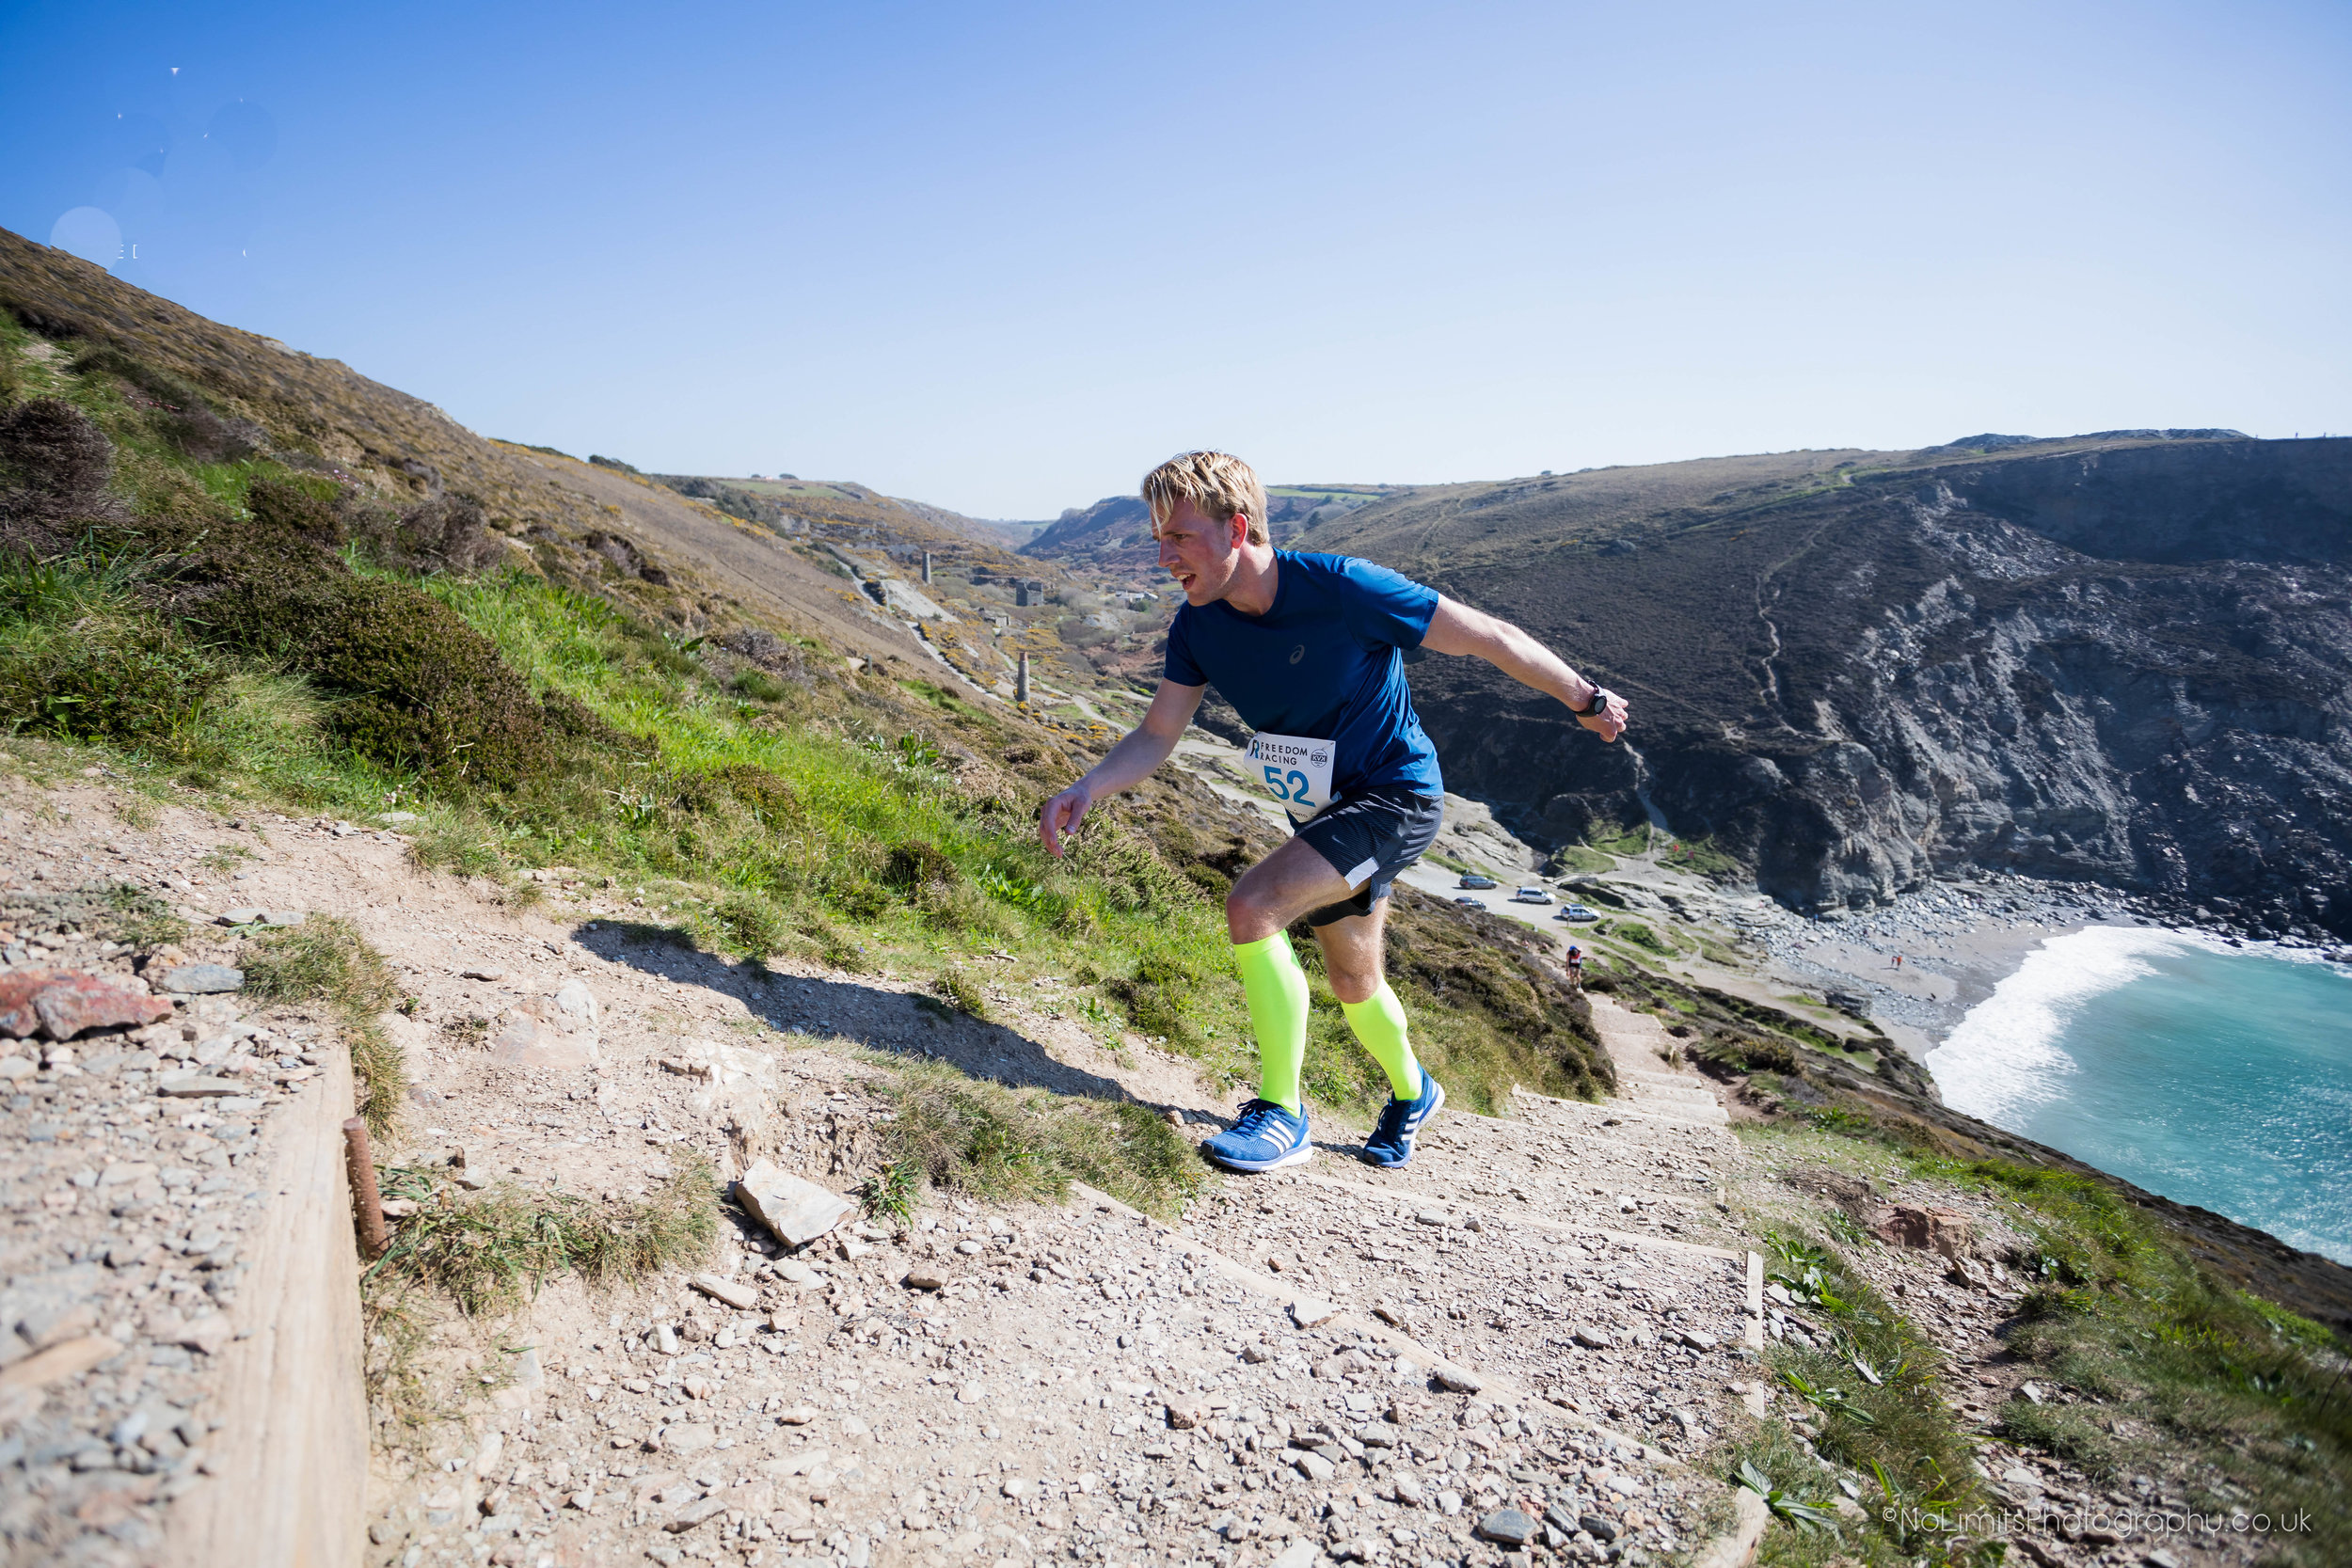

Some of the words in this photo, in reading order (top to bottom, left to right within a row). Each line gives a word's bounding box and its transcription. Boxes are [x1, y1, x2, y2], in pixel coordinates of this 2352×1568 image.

[1261, 741, 1308, 756] FREEDOM
[1261, 752, 1297, 766] RACING
[1263, 765, 1316, 808] 52
